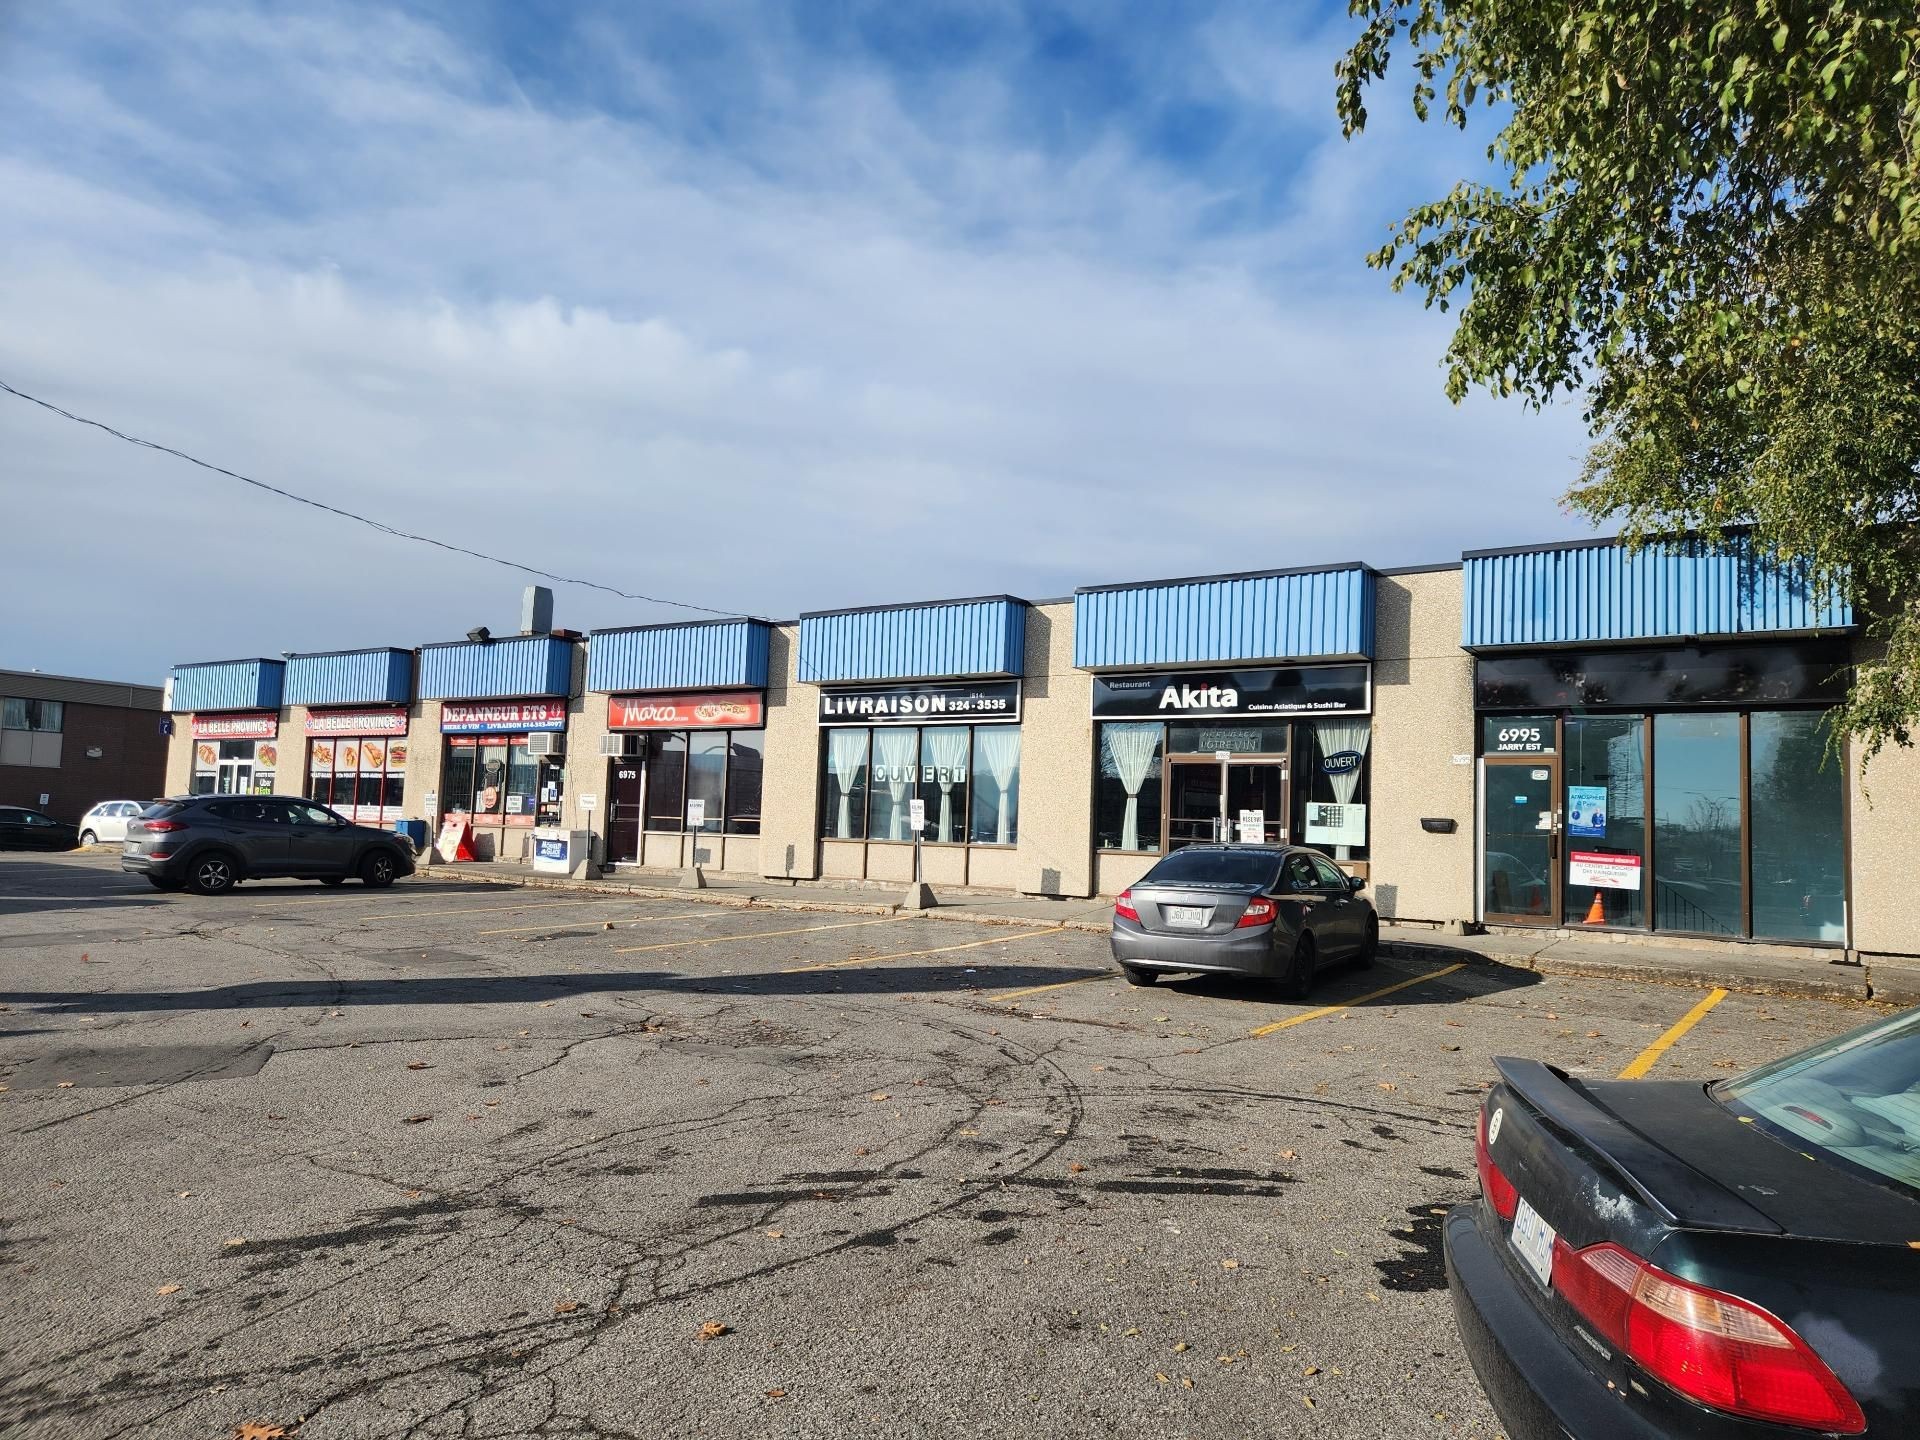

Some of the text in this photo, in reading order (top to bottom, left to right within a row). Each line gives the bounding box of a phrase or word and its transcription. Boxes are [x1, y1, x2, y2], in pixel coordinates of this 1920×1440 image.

[1109, 680, 1151, 689] Restaurant
[1158, 683, 1238, 709] Akita
[824, 694, 946, 714] LIVRAISON
[442, 705, 547, 722] DEPANNEUR ETS
[623, 698, 676, 726] Marco
[198, 719, 268, 734] LA BELLE PROVINCE
[313, 714, 396, 730] LA BELLE PROVINCE
[1498, 728, 1540, 742] 6995
[1497, 743, 1541, 751] JARRY EST
[1324, 755, 1357, 769] OUVERT
[619, 770, 636, 779] 6975
[876, 766, 965, 782] OUVERT
